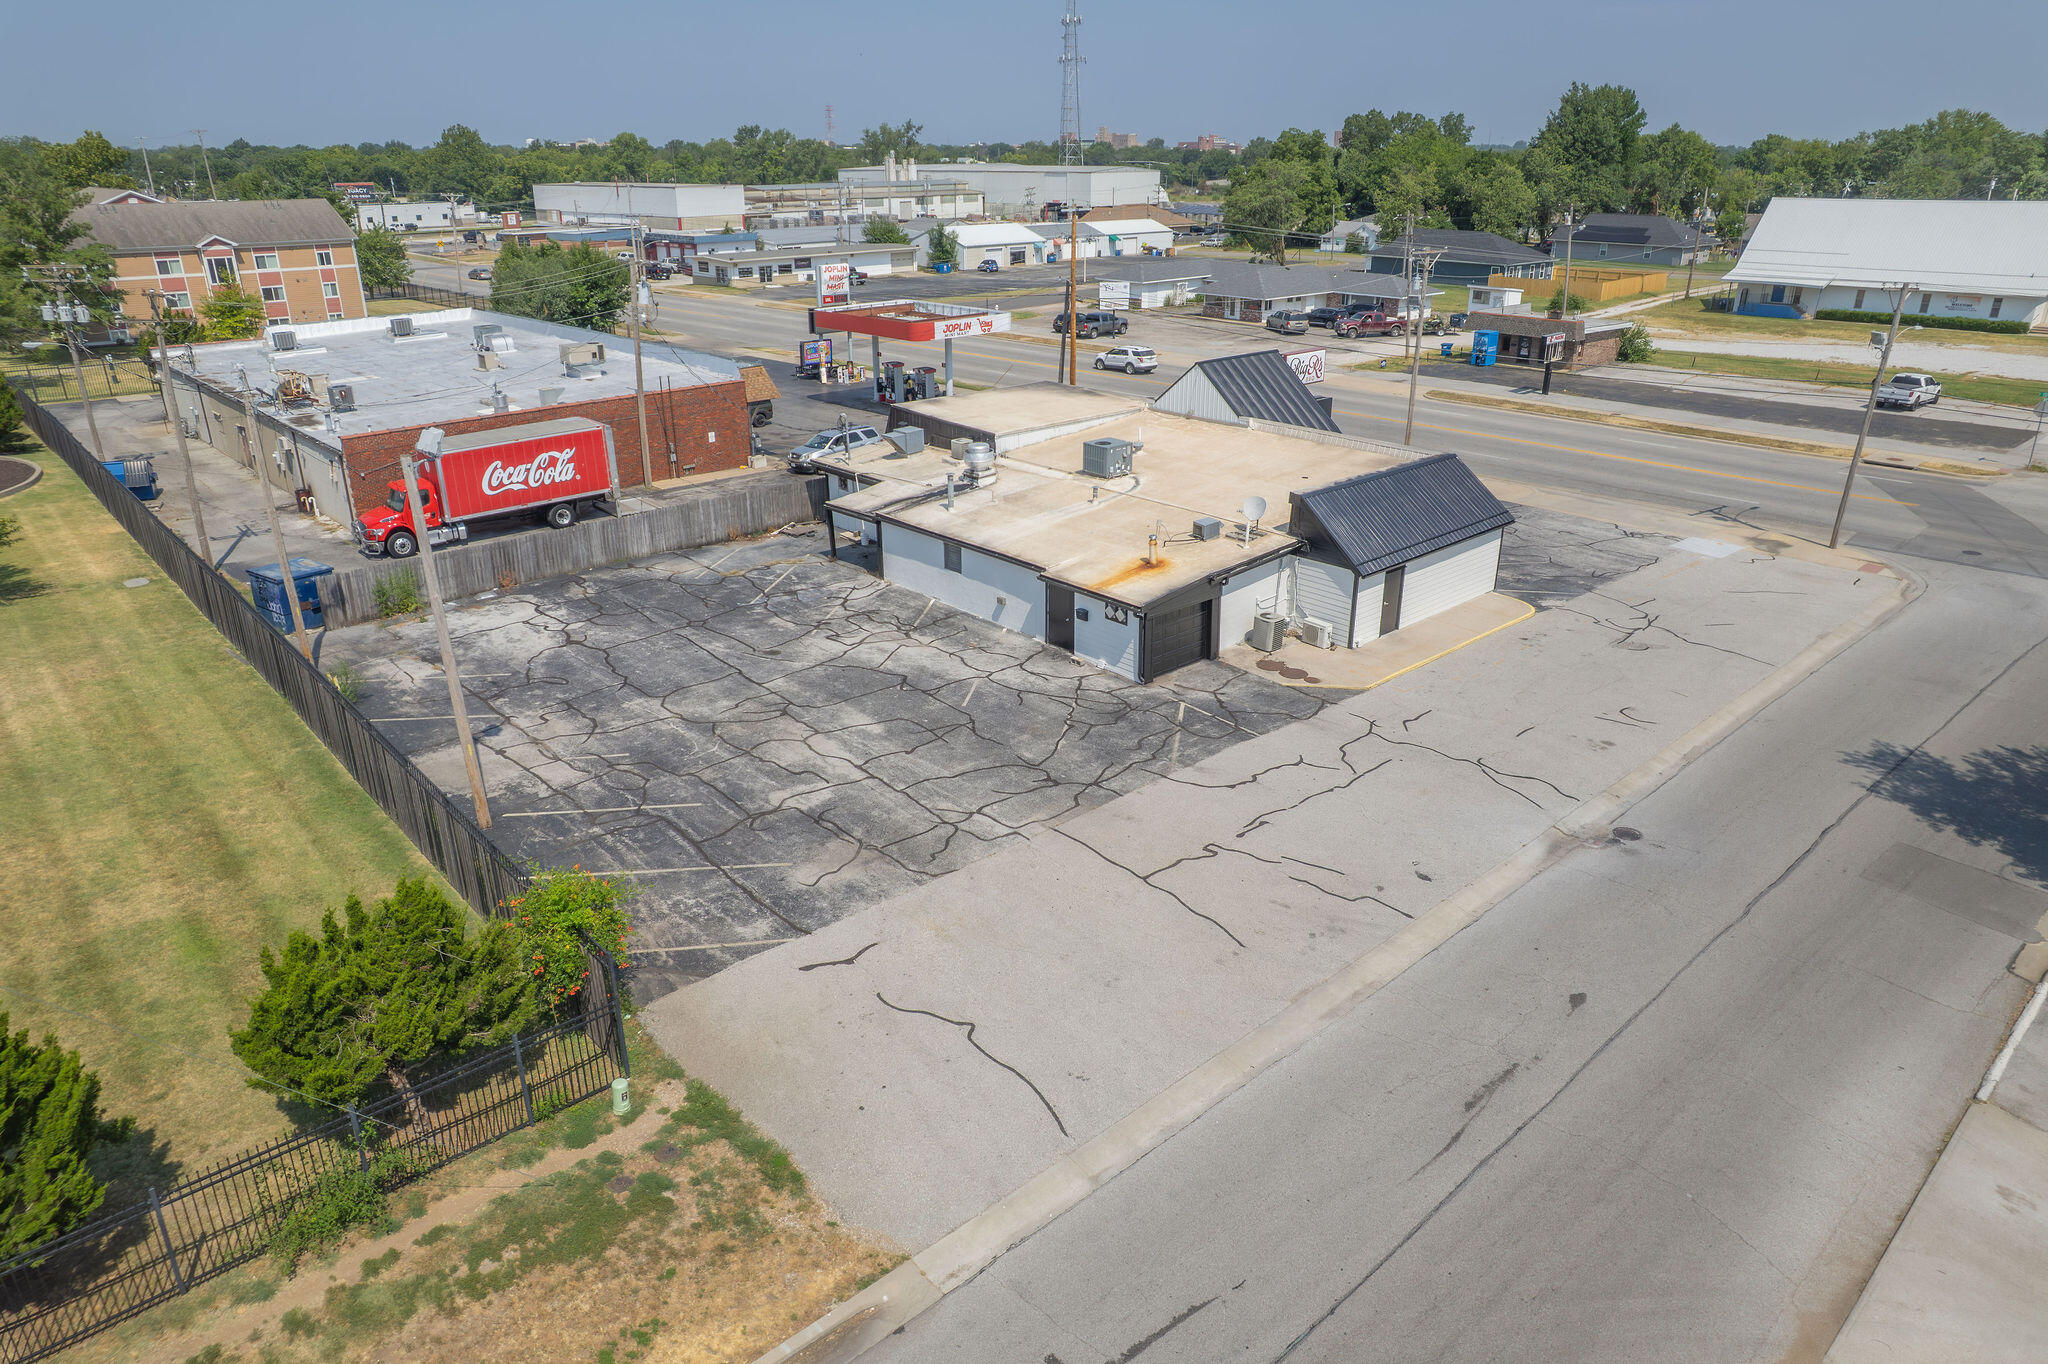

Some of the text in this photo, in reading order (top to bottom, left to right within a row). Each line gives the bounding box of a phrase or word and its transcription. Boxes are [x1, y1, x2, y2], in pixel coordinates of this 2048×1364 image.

[824, 265, 847, 273] JOPLIN
[943, 322, 971, 333] JOPLIN
[482, 447, 576, 496] Coca-Cola
